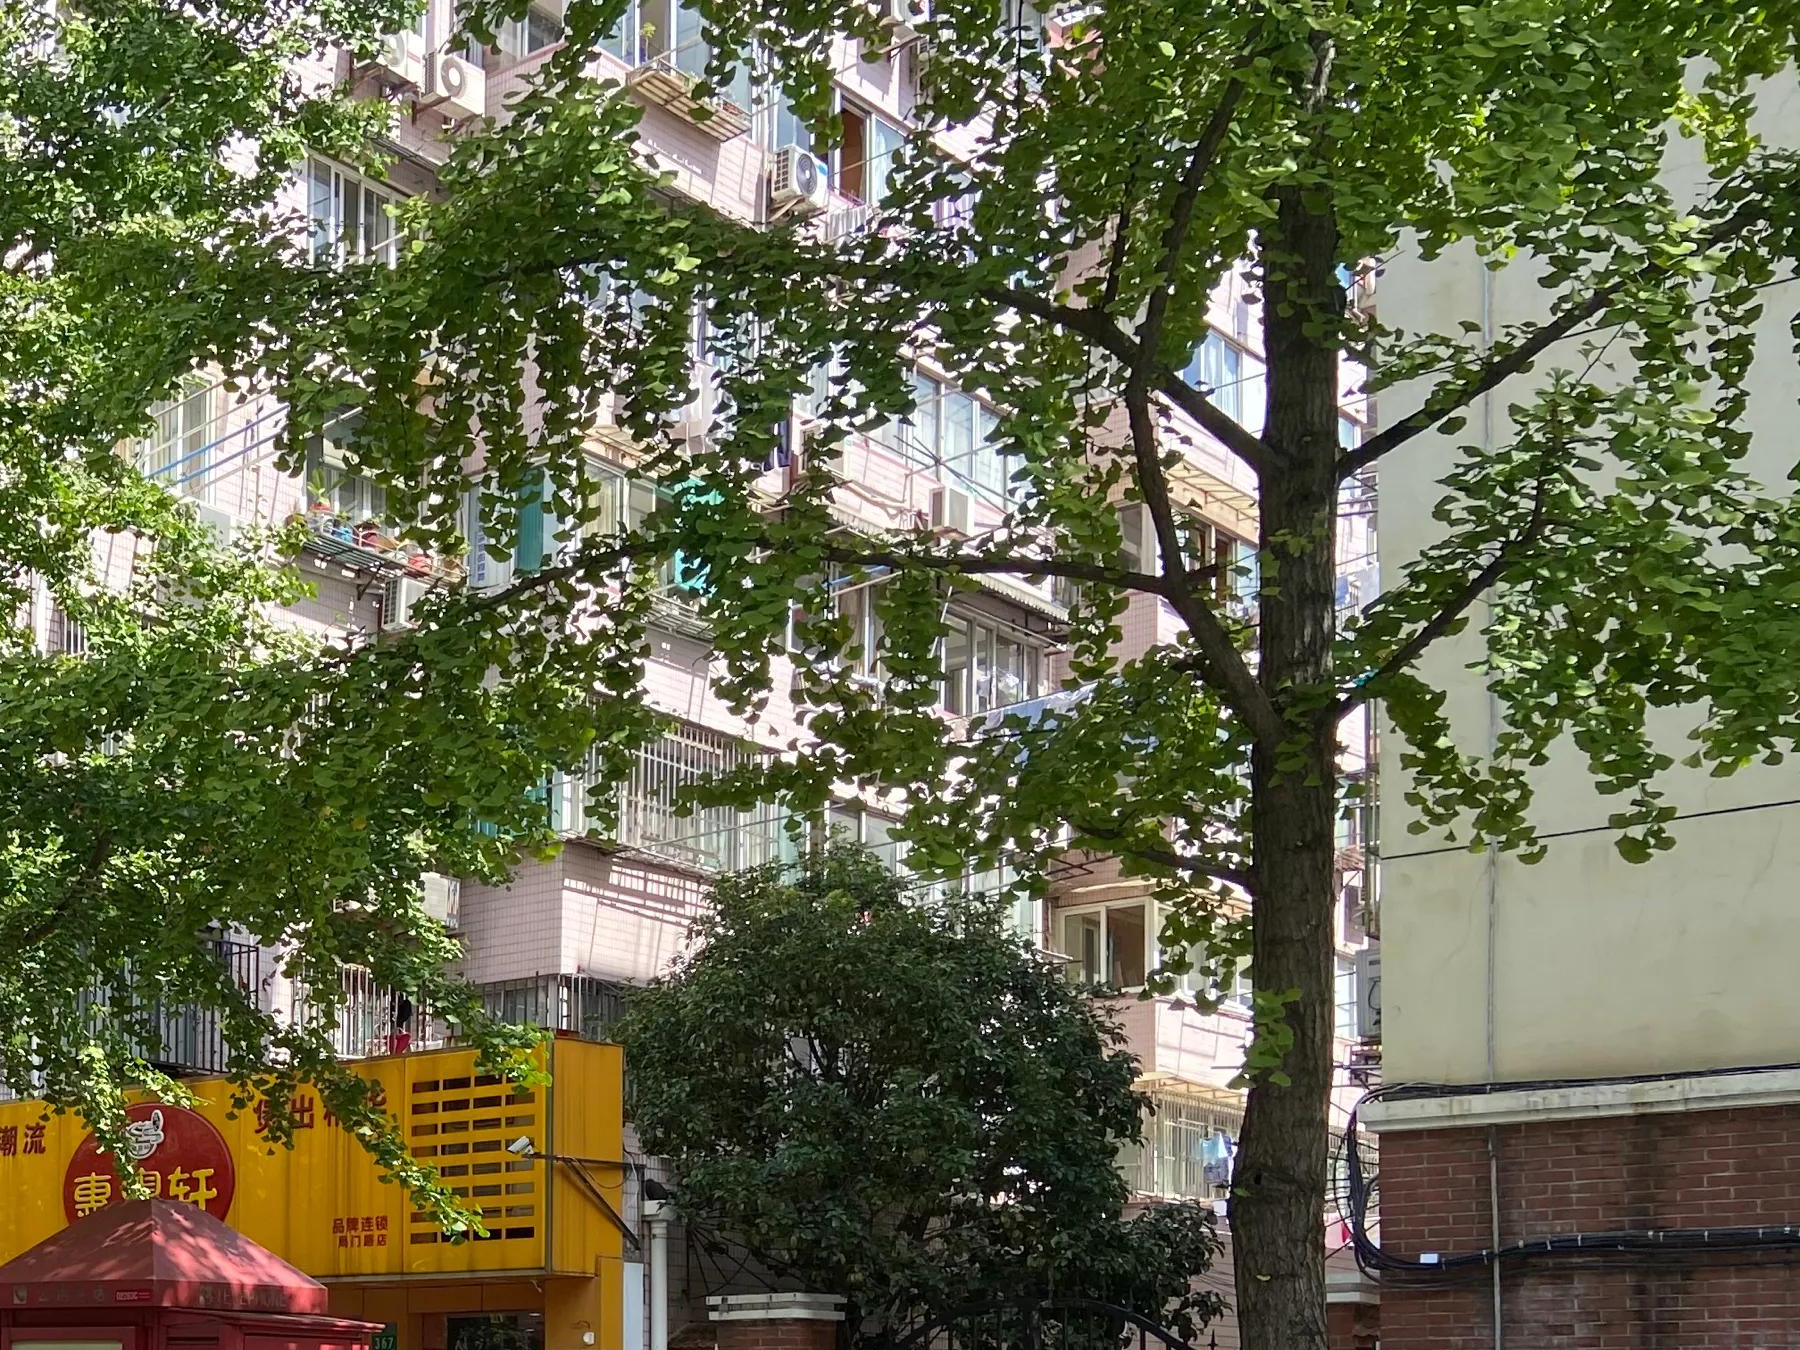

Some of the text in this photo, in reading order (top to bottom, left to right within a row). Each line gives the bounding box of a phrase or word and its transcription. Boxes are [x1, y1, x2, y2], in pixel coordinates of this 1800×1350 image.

[332, 1215, 388, 1235] 品牌连锁
[375, 1337, 394, 1350] 367
